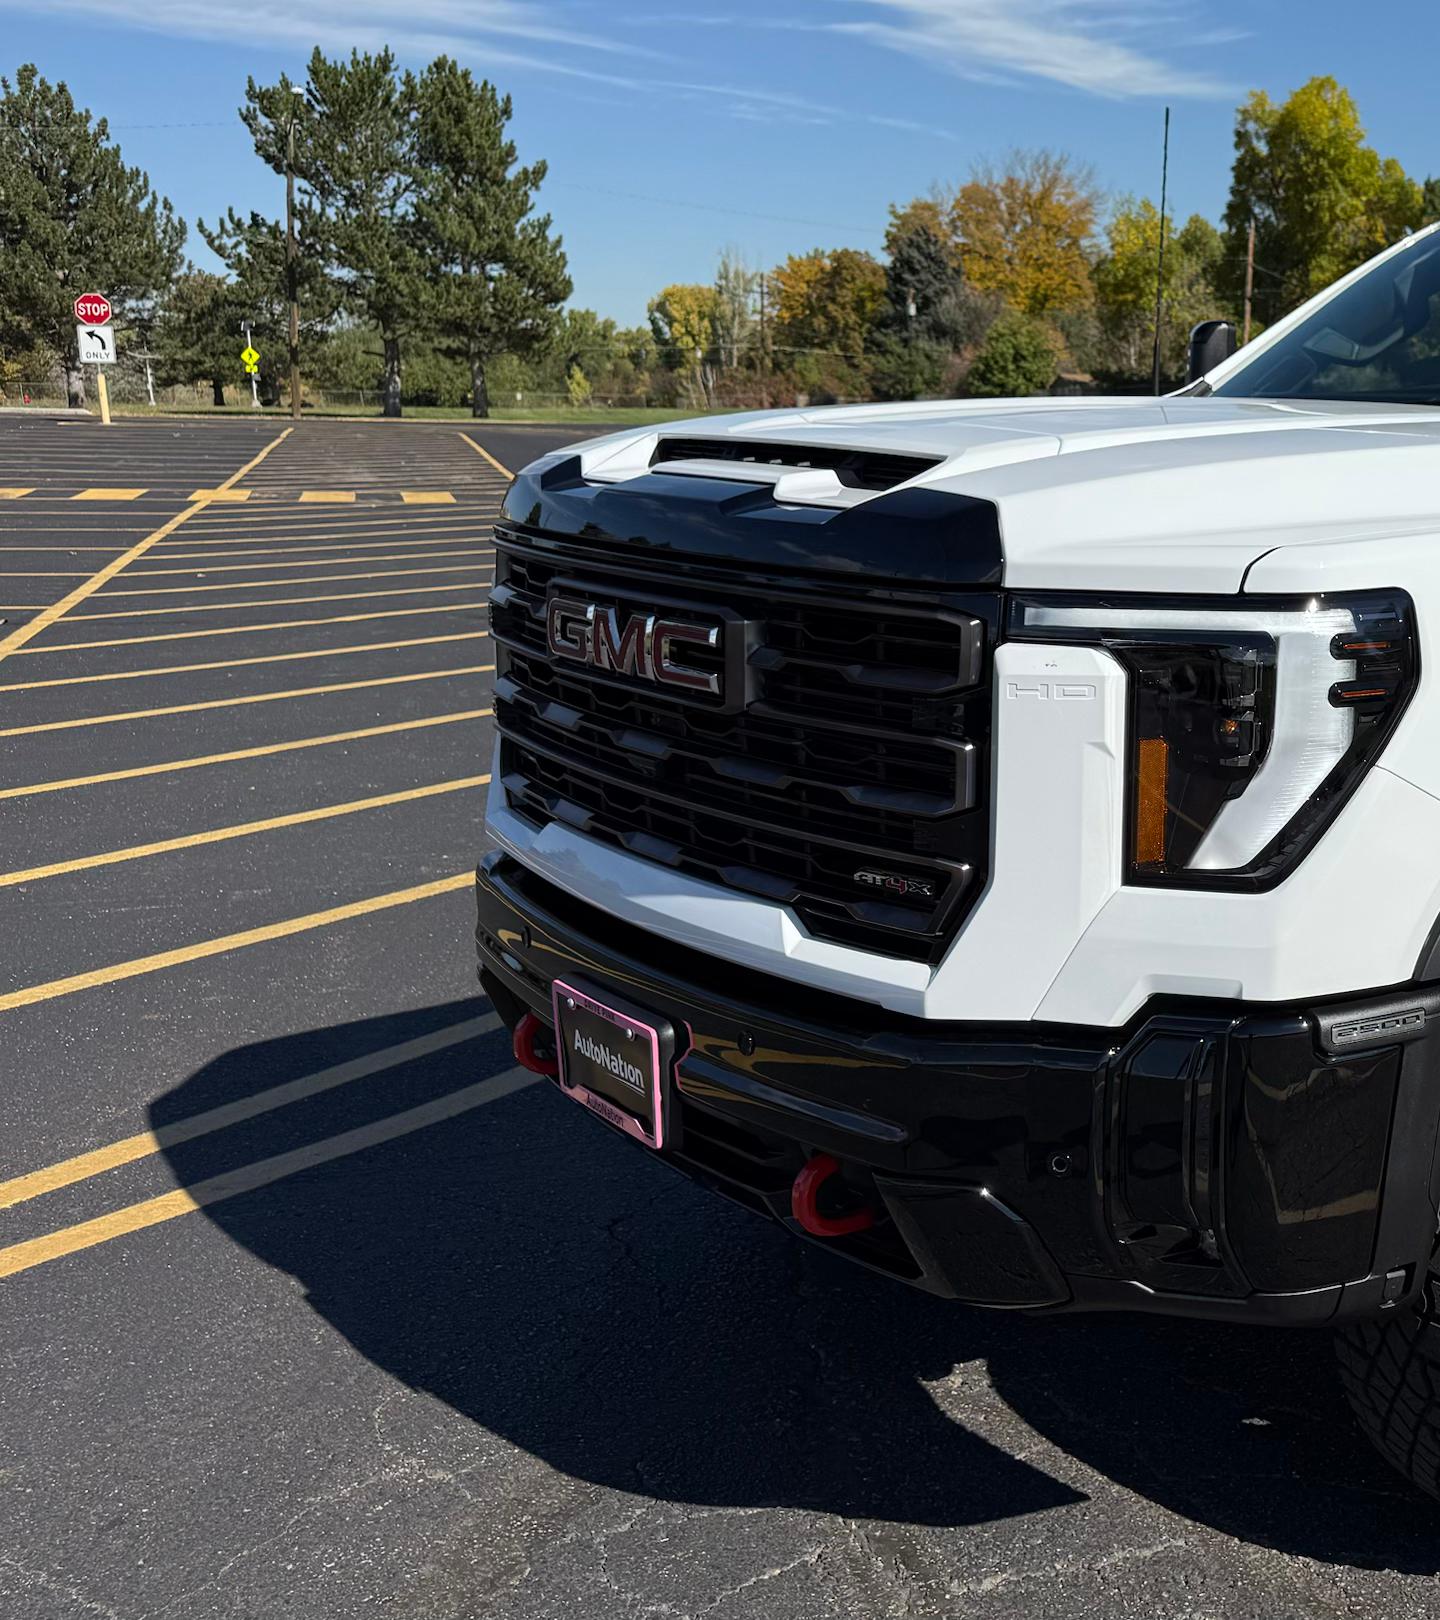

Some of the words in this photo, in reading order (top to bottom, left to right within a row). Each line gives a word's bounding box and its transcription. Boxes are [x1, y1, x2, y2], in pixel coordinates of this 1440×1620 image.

[78, 303, 108, 316] STOP
[85, 351, 110, 360] ONLY
[547, 598, 719, 694] GMC
[1007, 683, 1096, 700] HD
[853, 869, 934, 897] AT4X
[1336, 1014, 1420, 1038] 2500
[574, 1029, 644, 1088] AutoNation
[586, 1093, 625, 1128] AutoNation
